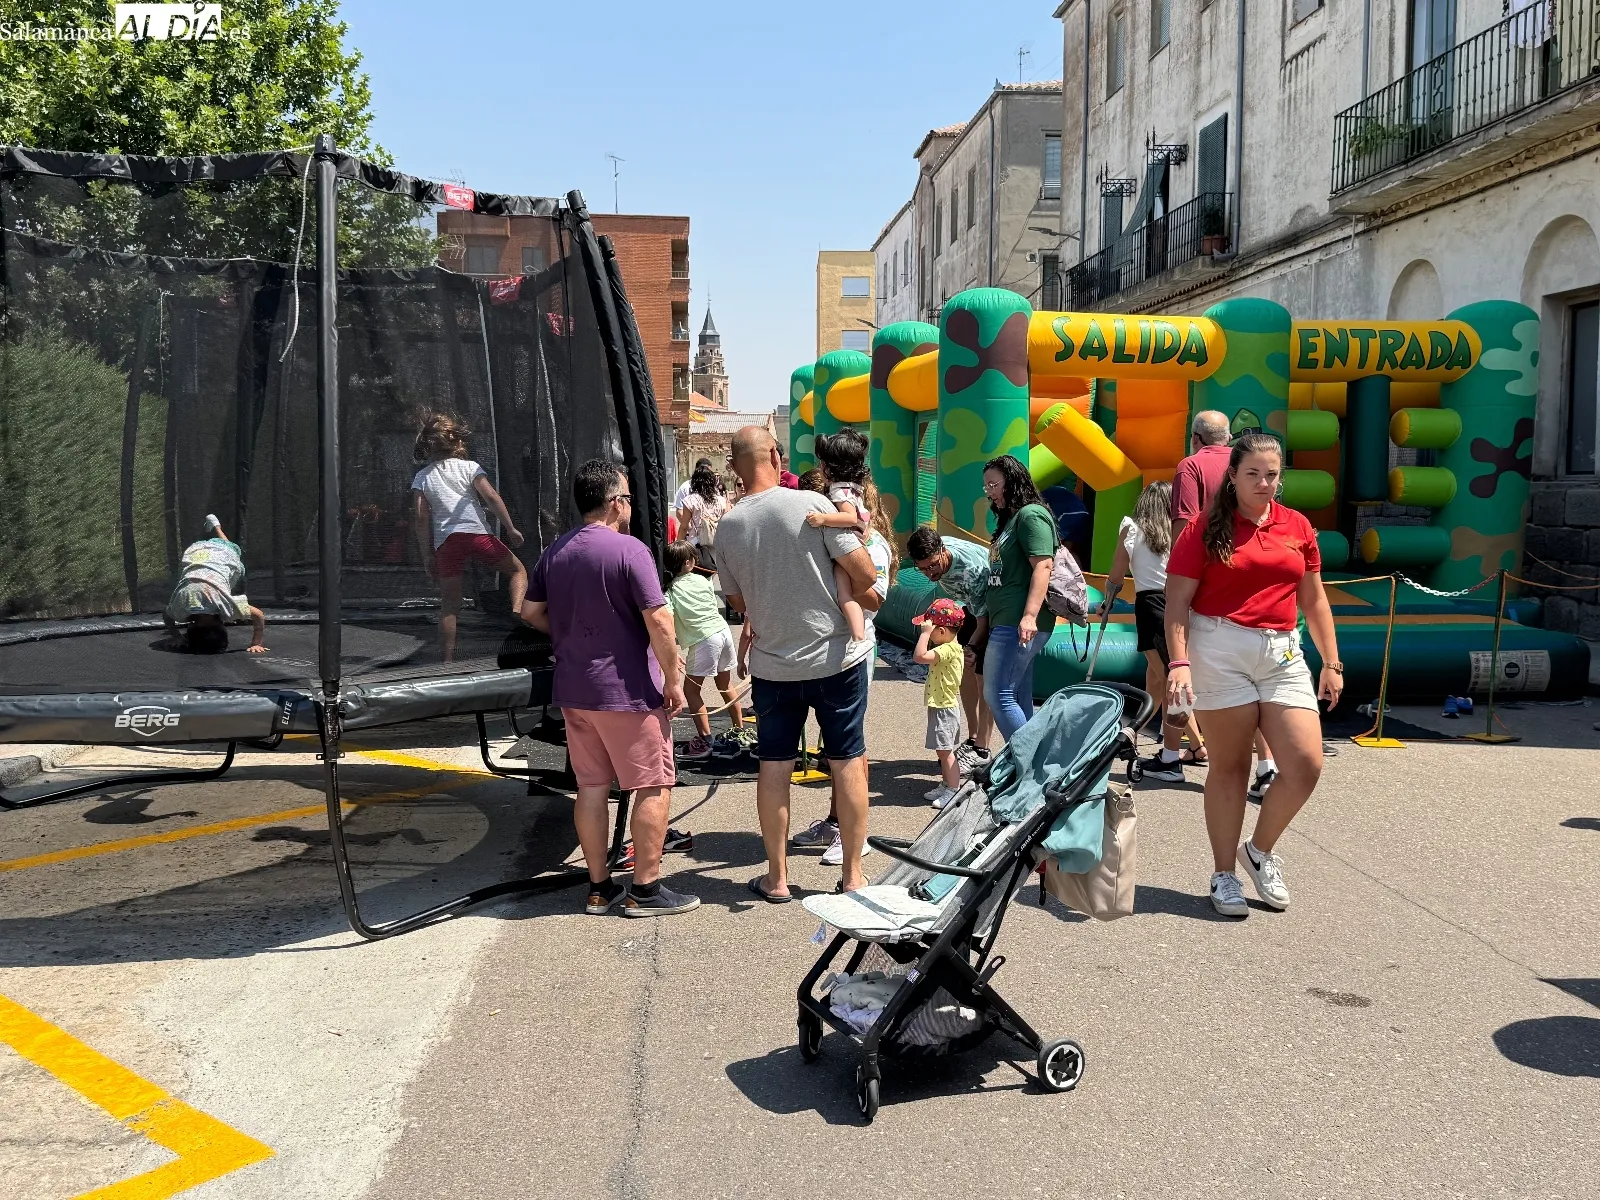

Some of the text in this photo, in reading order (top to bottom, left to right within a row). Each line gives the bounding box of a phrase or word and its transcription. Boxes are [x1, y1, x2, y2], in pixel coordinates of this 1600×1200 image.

[1051, 315, 1209, 368] SALIDA
[1297, 328, 1472, 371] ENTRADA
[114, 713, 181, 728] BERG
[281, 700, 293, 725] ELITE
